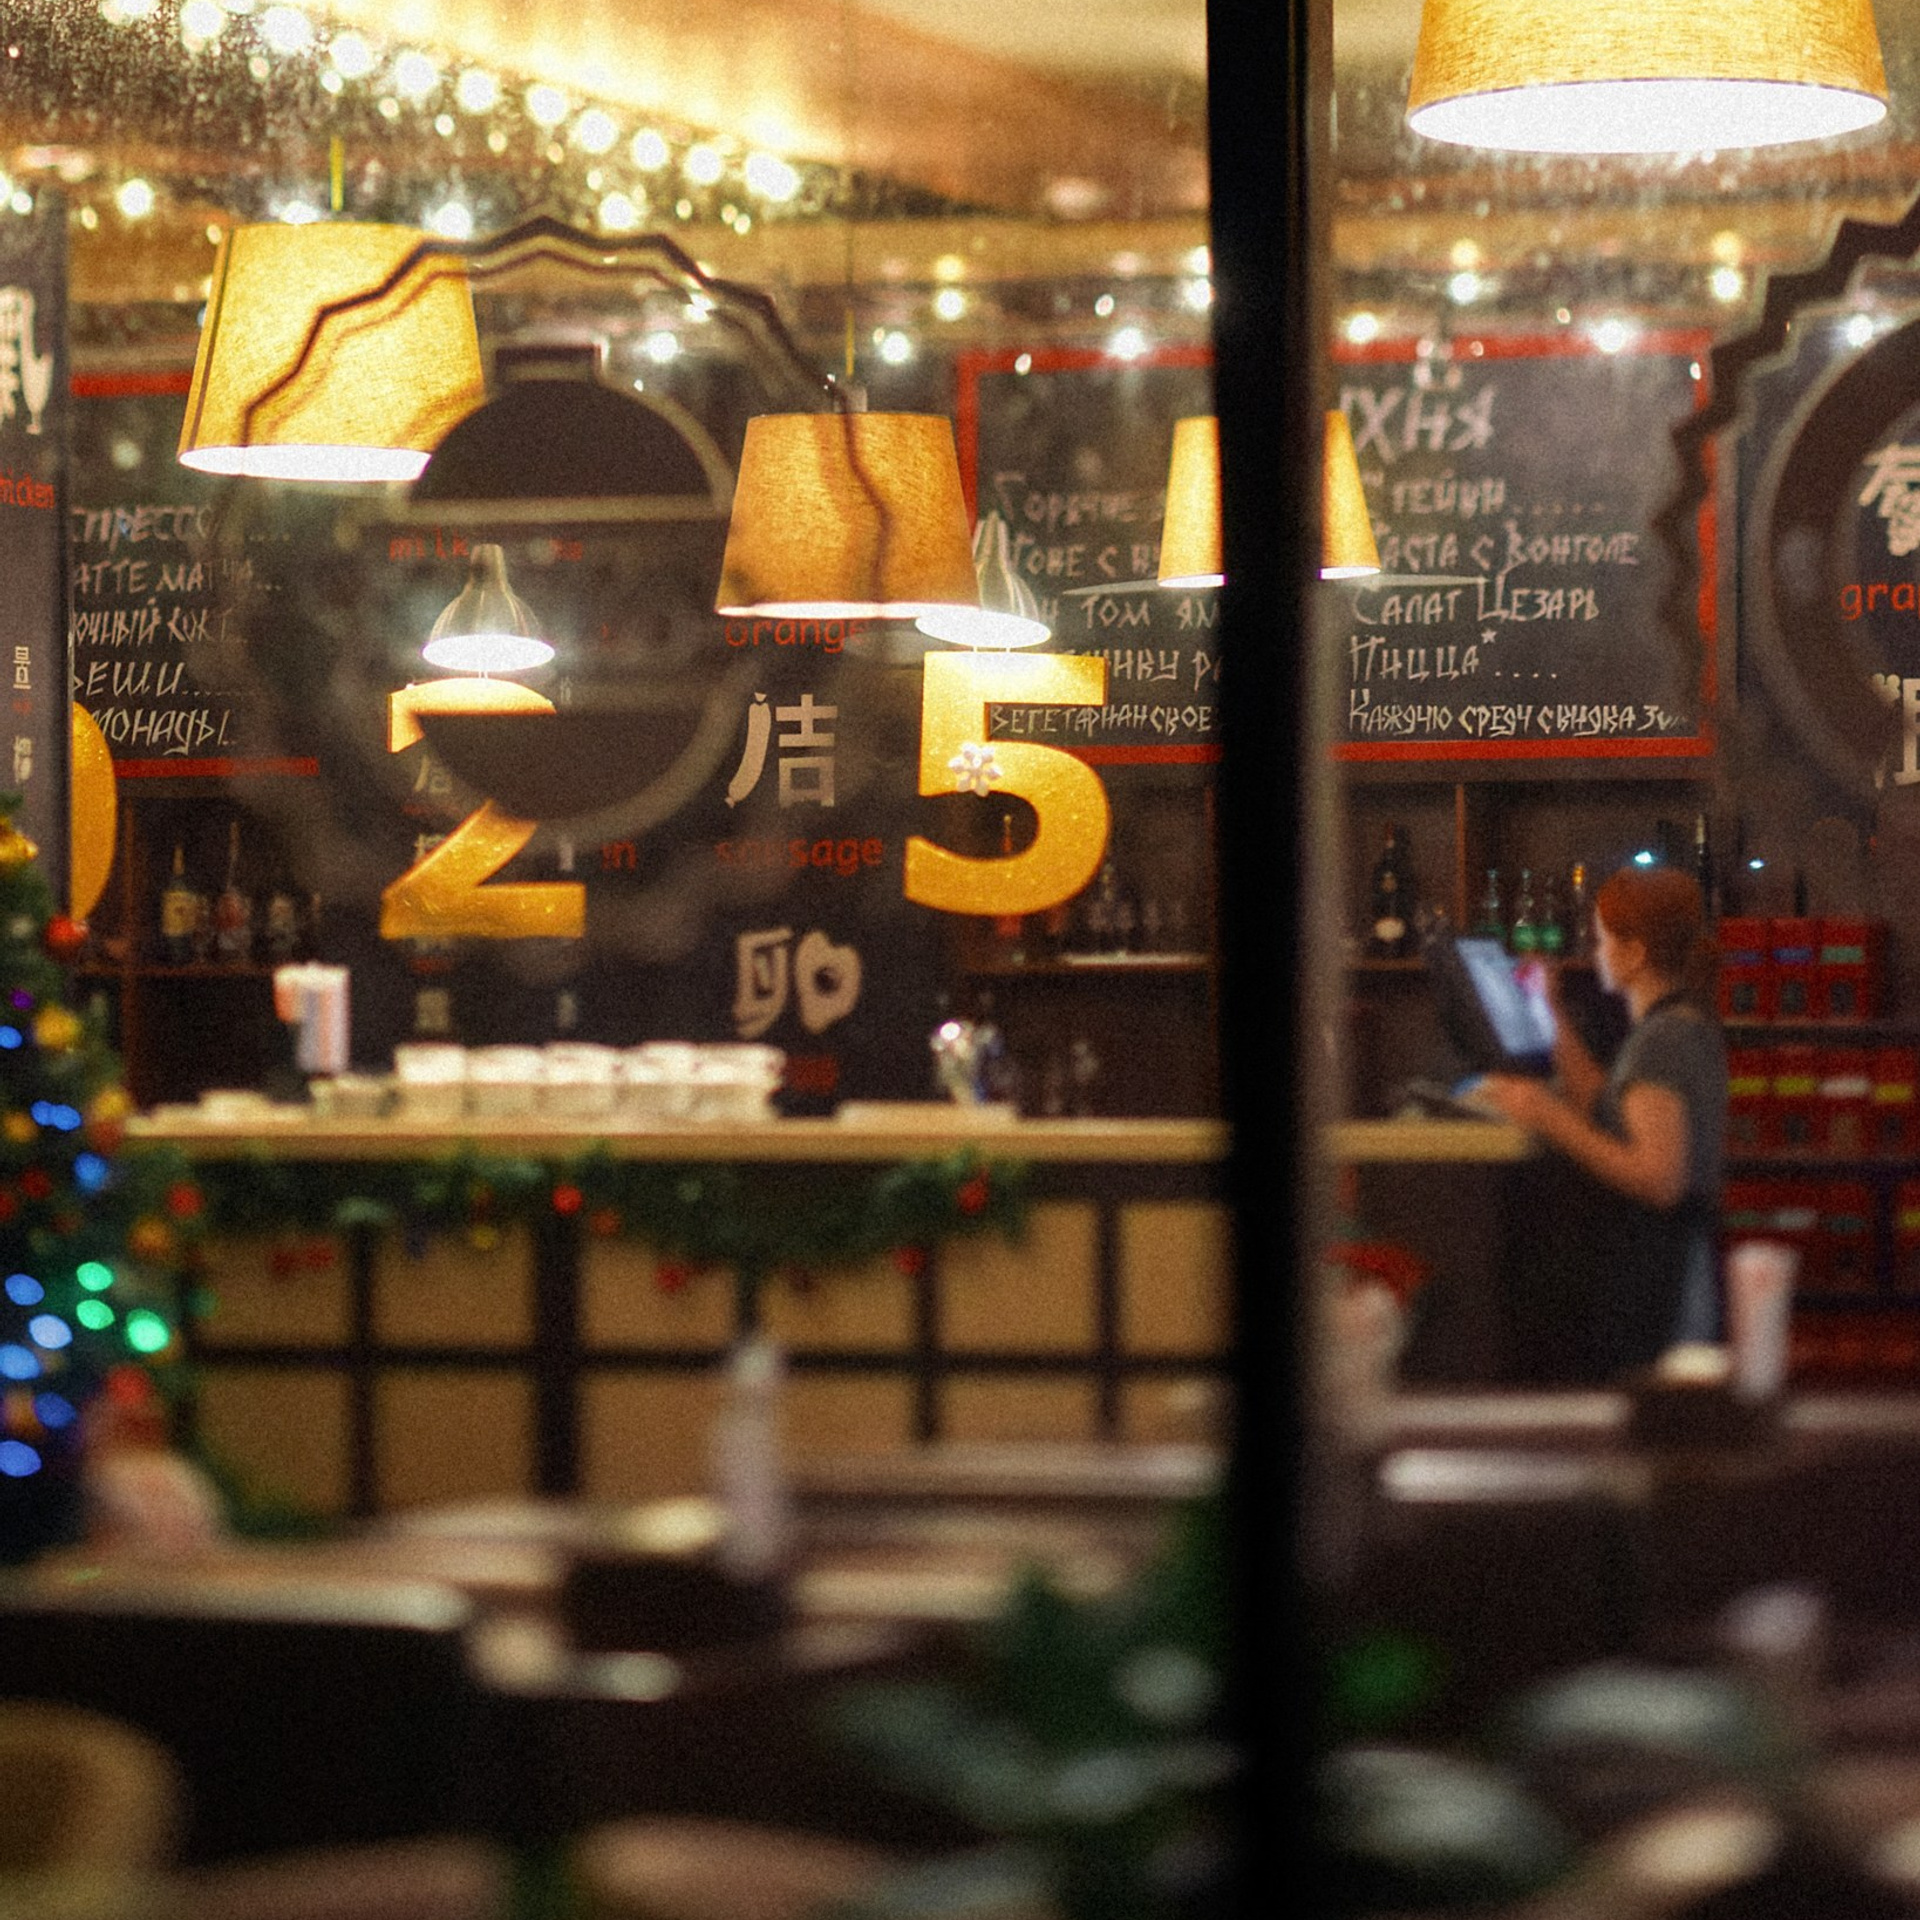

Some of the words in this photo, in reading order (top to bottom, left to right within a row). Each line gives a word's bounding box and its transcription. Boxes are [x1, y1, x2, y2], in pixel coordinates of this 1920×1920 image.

[1373, 521, 1459, 573] АСТА
[1080, 594, 1151, 630] ТОМ
[1353, 585, 1463, 626] САЛАТ
